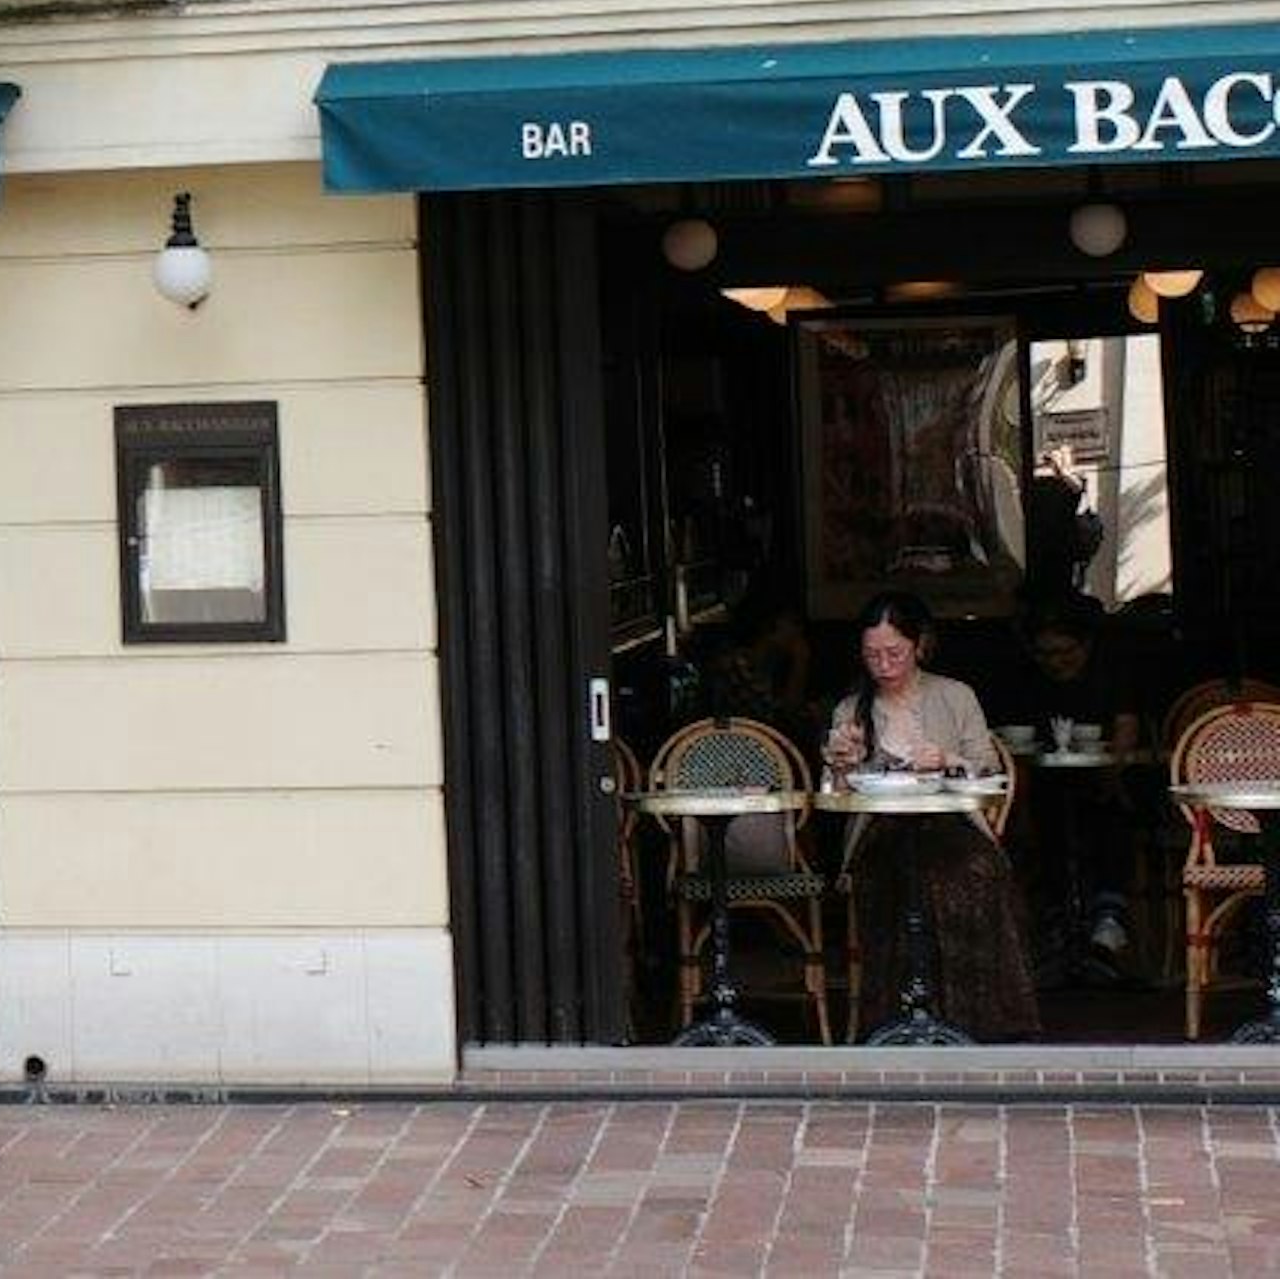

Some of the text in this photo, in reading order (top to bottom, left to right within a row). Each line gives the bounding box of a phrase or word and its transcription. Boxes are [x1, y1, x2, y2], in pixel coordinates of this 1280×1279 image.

[521, 71, 1280, 167] BAR AUX BAC
